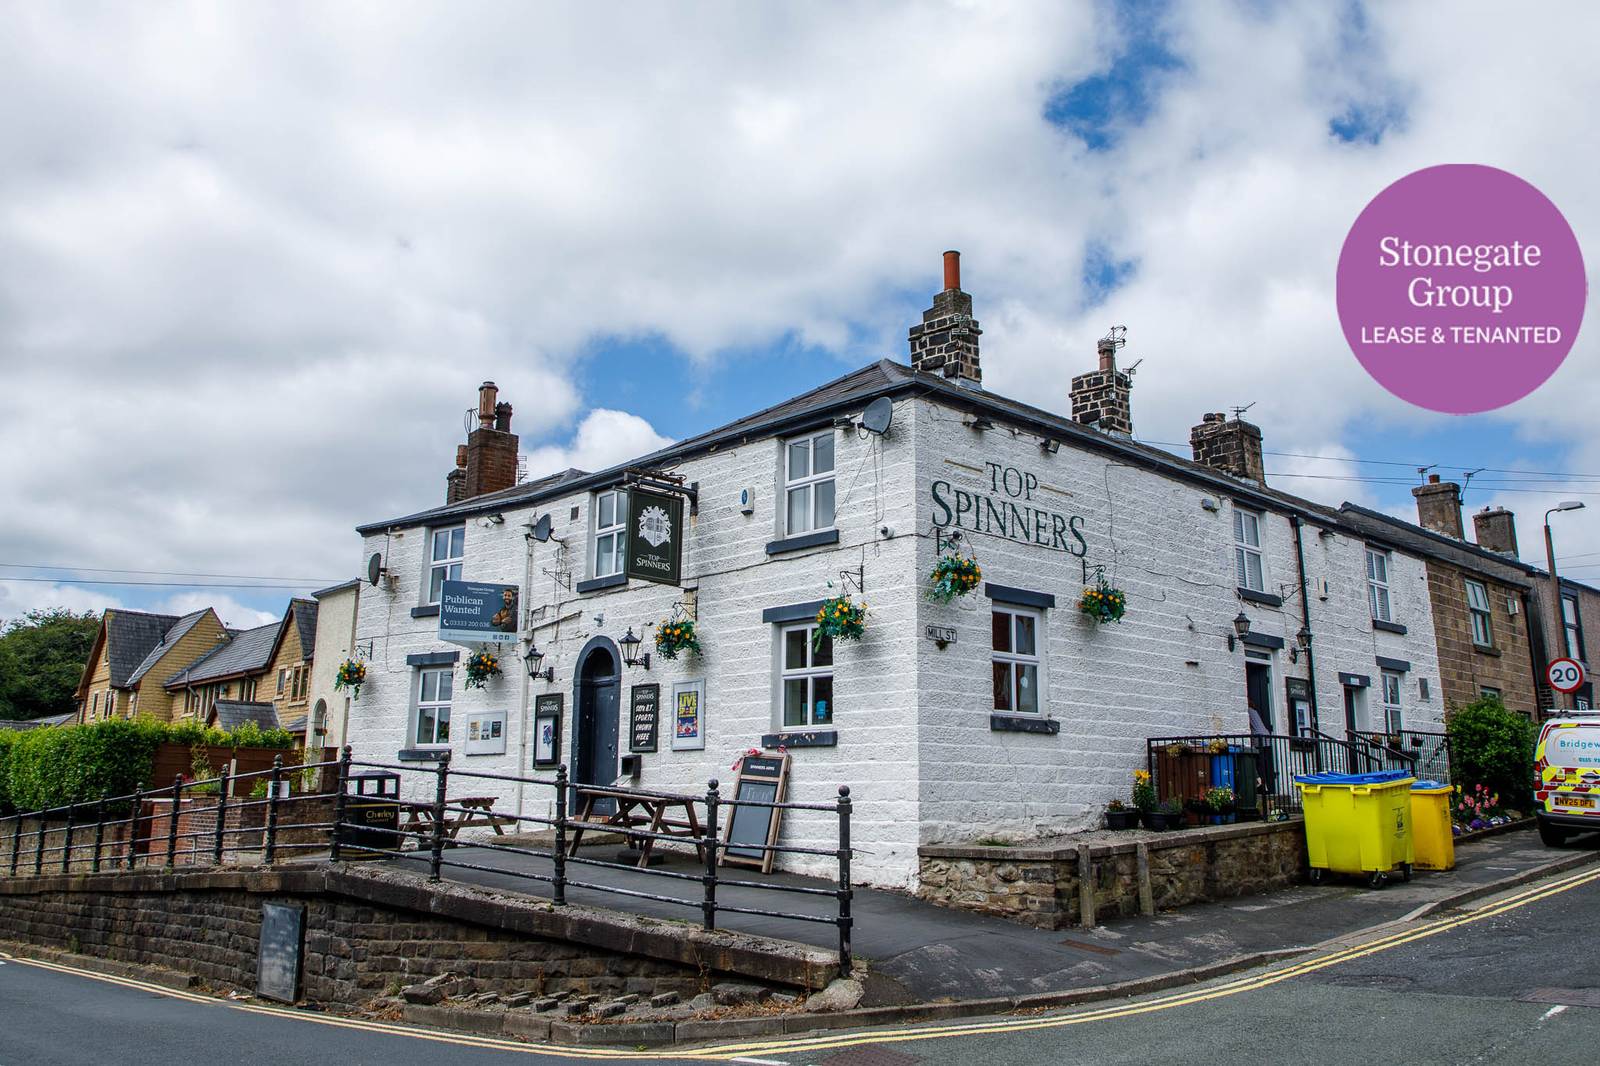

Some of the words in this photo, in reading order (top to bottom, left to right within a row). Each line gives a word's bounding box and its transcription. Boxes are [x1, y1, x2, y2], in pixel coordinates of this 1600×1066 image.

[985, 461, 1038, 500] TOP
[931, 480, 1088, 557] SPINNERS
[636, 557, 670, 571] SPINNERS
[445, 595, 483, 605] Publican
[444, 605, 481, 615] Wanted!
[927, 627, 943, 639] MILL
[946, 630, 956, 641] ST
[1552, 667, 1578, 683] 20
[635, 733, 650, 741] HERE
